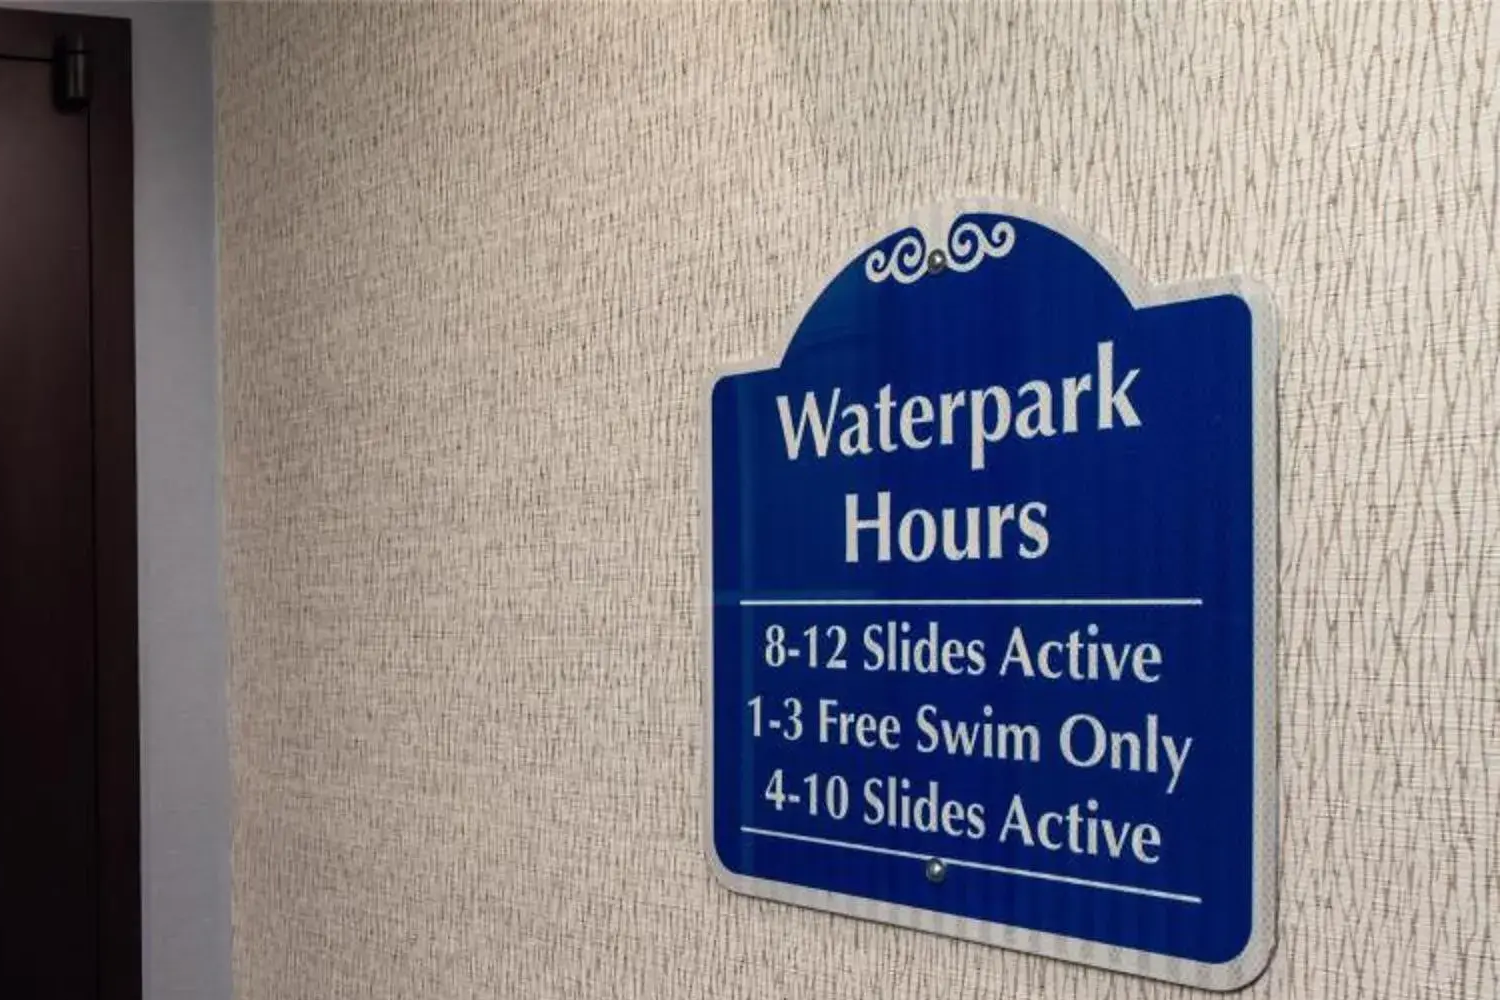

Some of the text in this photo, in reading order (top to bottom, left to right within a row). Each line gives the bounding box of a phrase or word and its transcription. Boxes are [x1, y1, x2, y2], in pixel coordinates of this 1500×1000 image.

[777, 341, 1141, 469] Waterpark
[845, 491, 1049, 563] Hours
[765, 621, 1162, 683] 8-12 Slides Active
[748, 696, 1192, 794] 1-3 Free Swim Only
[765, 769, 1161, 863] 4-10 Slides Active
